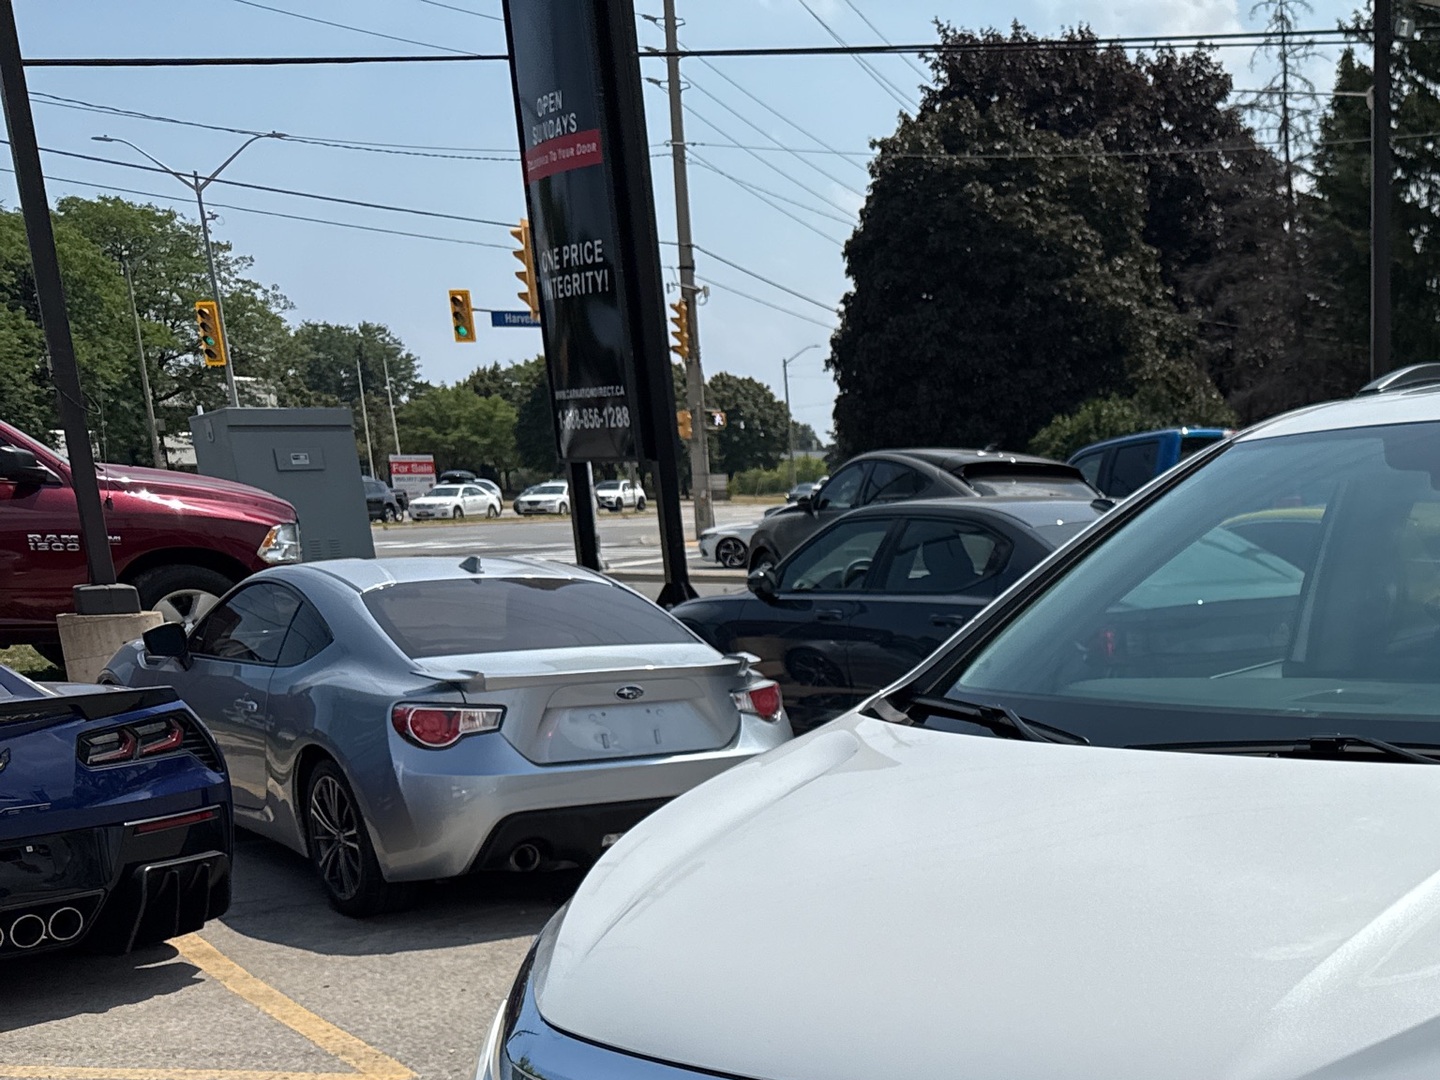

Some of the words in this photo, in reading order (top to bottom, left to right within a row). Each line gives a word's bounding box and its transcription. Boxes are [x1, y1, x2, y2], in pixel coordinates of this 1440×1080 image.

[536, 90, 563, 117] OPEN
[532, 112, 578, 146] SUNDAYS
[541, 247, 560, 273] ONE
[562, 239, 604, 268] PRICE
[392, 463, 409, 473] For
[411, 463, 433, 473] Sale
[27, 534, 79, 542] RAM
[28, 543, 80, 552] 1500
